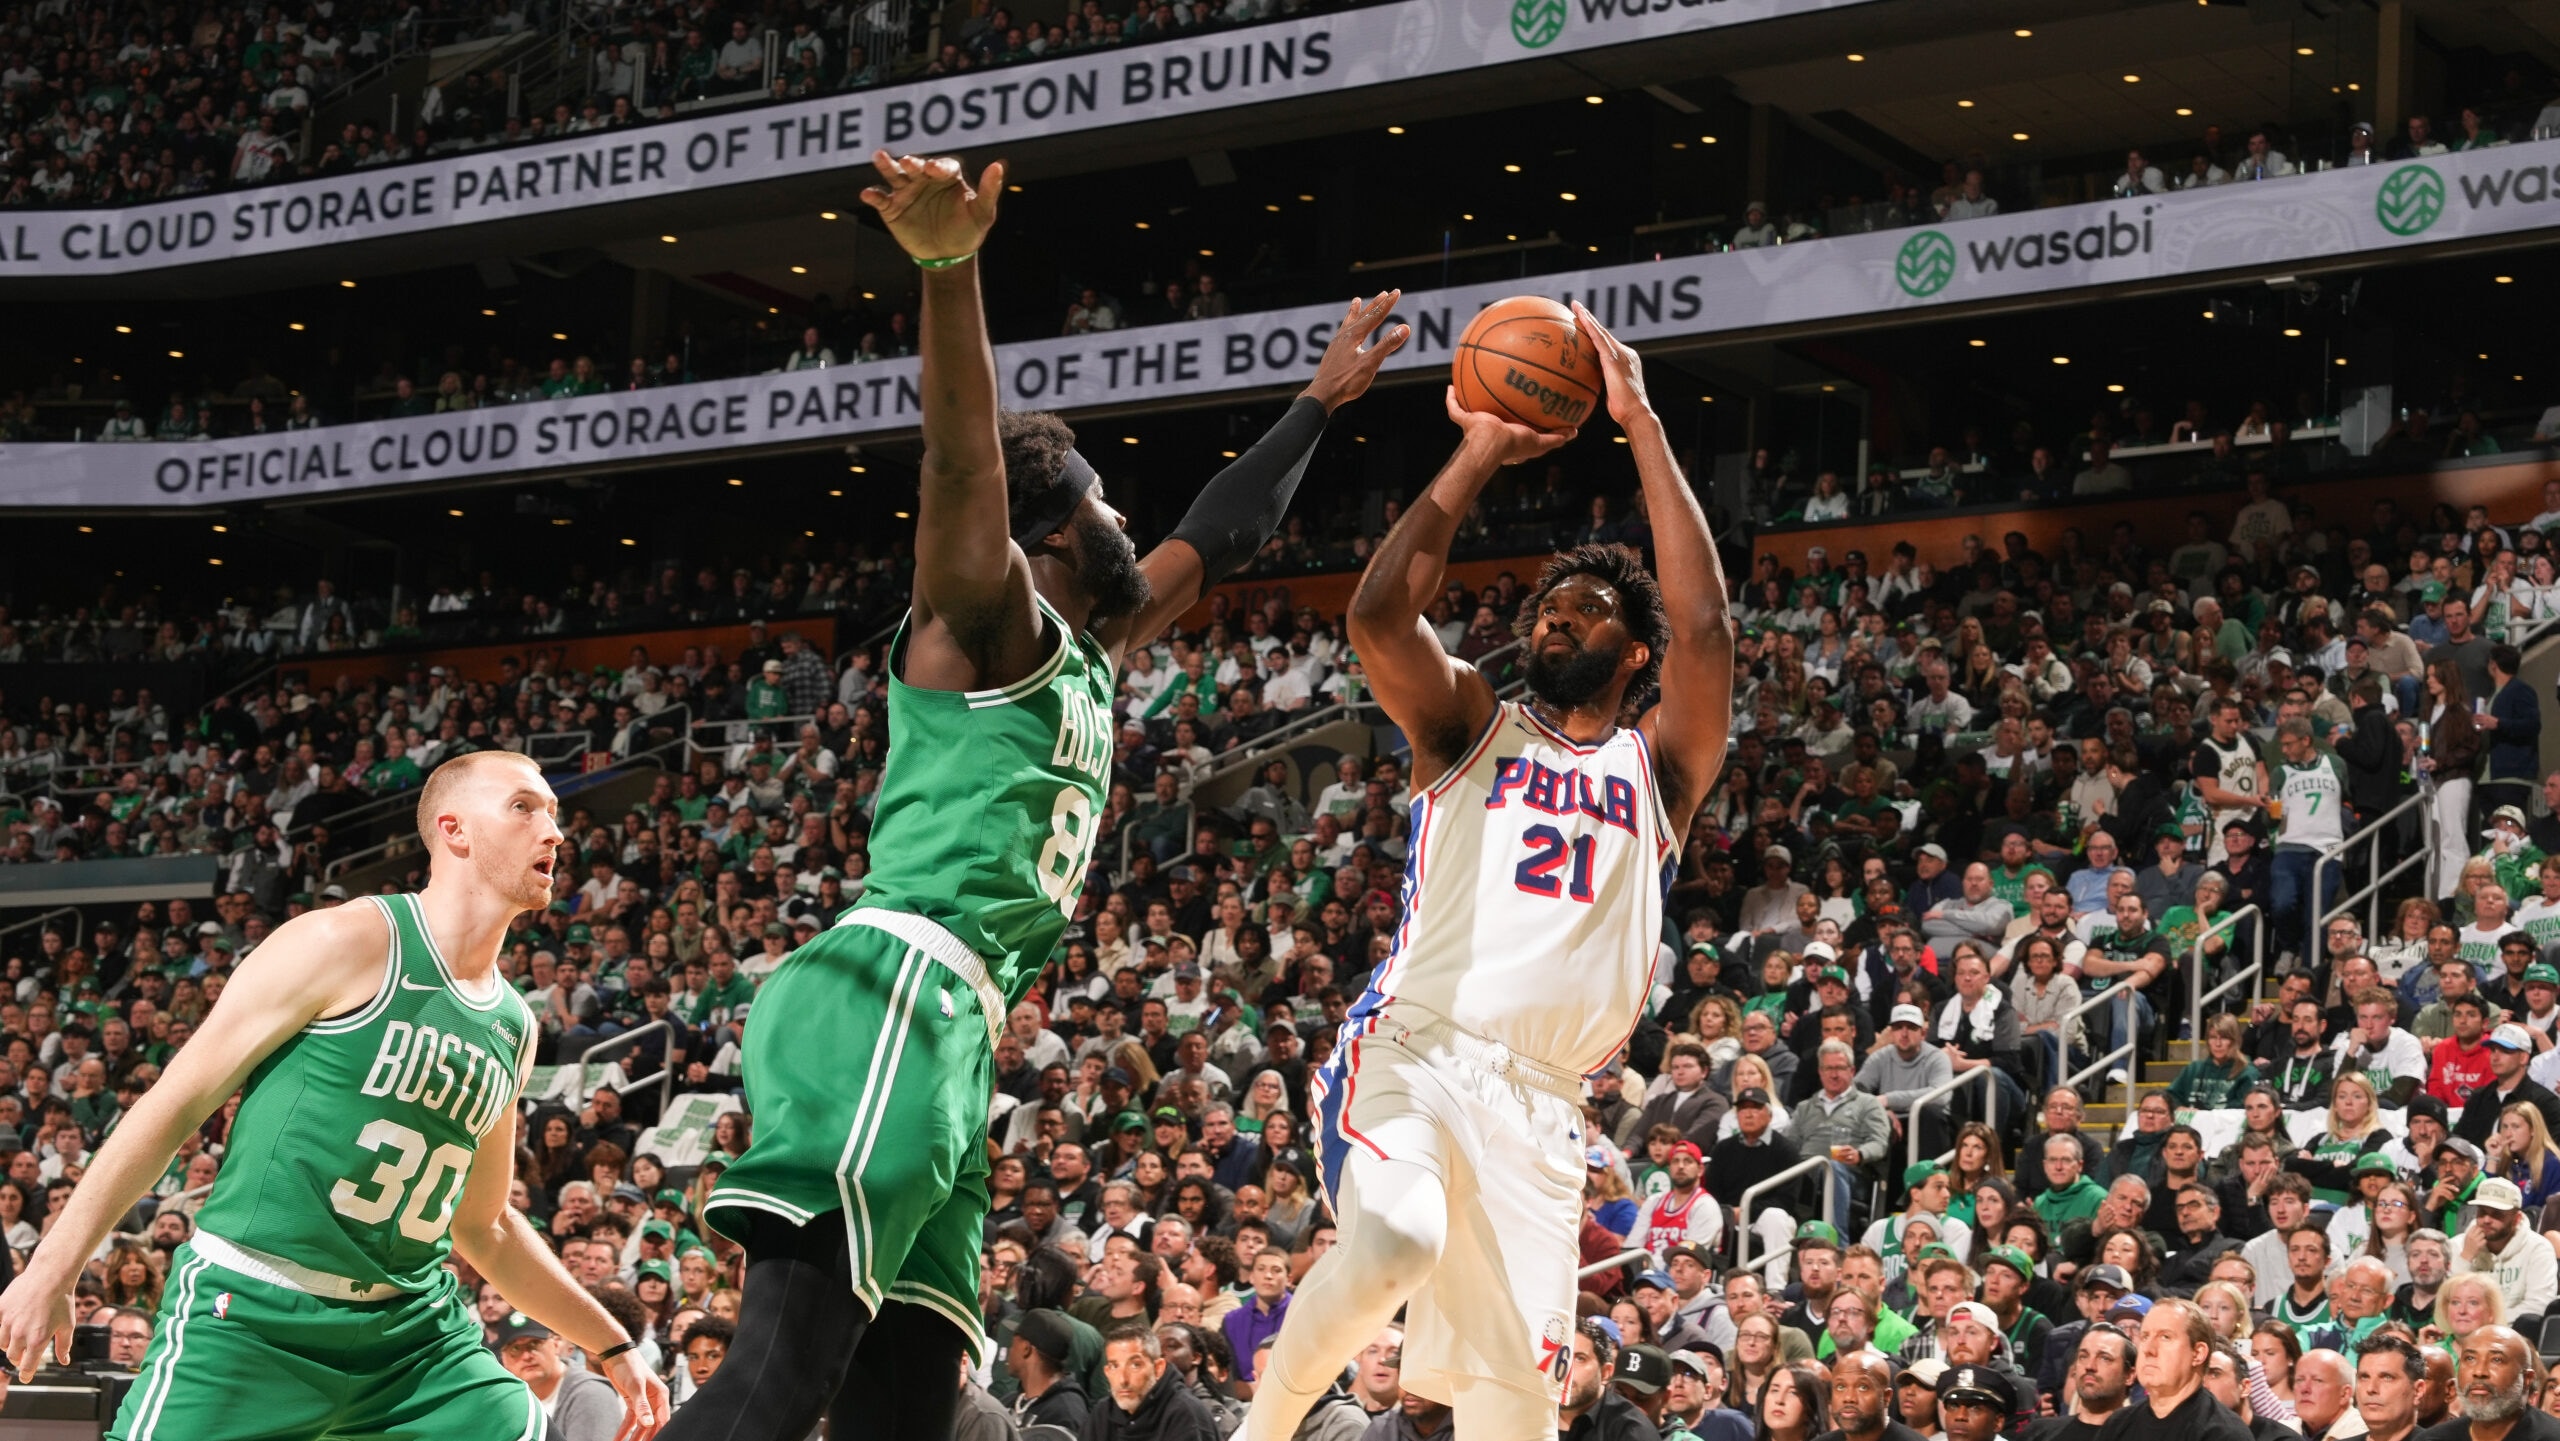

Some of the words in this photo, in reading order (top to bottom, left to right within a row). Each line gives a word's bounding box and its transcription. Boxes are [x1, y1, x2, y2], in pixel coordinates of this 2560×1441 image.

[62, 211, 216, 260] CLOUD
[232, 176, 435, 242] STORAGE
[453, 140, 666, 211] PARTNER
[687, 126, 749, 173] OF
[769, 107, 862, 161] THE
[884, 69, 1097, 143] BOSTON
[1122, 31, 1331, 105] BRUINS
[1969, 205, 2155, 274] wasabi
[156, 440, 351, 494] OFFICIAL
[369, 422, 518, 472] CLOUD
[535, 396, 747, 455] STORAGE
[767, 375, 922, 429] PARTN
[1015, 354, 1080, 399] OF
[1103, 339, 1200, 389] THE
[1224, 307, 1451, 376] BOSON
[1485, 756, 1638, 839] PHILA
[2287, 777, 2336, 797] CELTICS
[2305, 792, 2322, 816] 7
[1515, 823, 1597, 904] 21
[491, 1019, 518, 1047] Amica
[360, 1020, 513, 1149] BOSTON
[329, 1118, 473, 1244] 30
[1626, 1352, 1642, 1372] B
